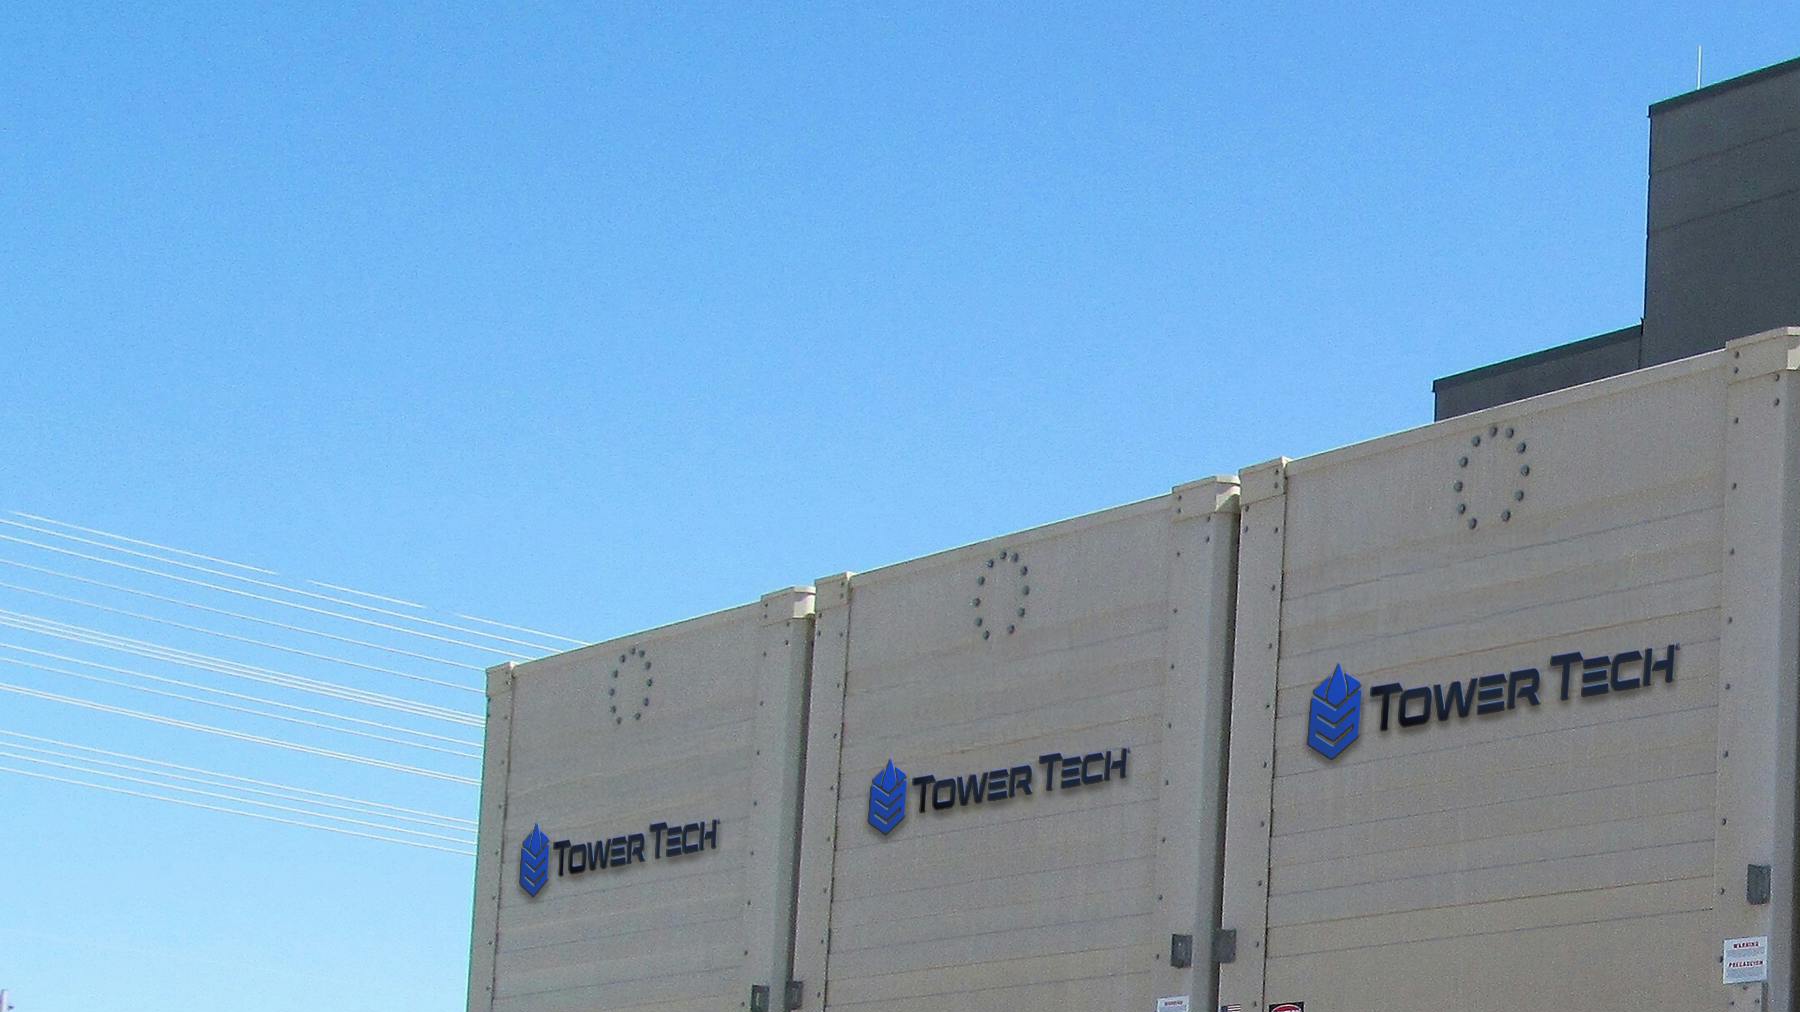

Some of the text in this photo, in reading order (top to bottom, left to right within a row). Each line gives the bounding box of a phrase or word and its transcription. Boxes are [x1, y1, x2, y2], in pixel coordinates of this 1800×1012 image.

[1369, 643, 1677, 732] TOWER TECH
[911, 747, 1129, 814] TOWER TECH
[552, 818, 719, 877] TOWER TECH
